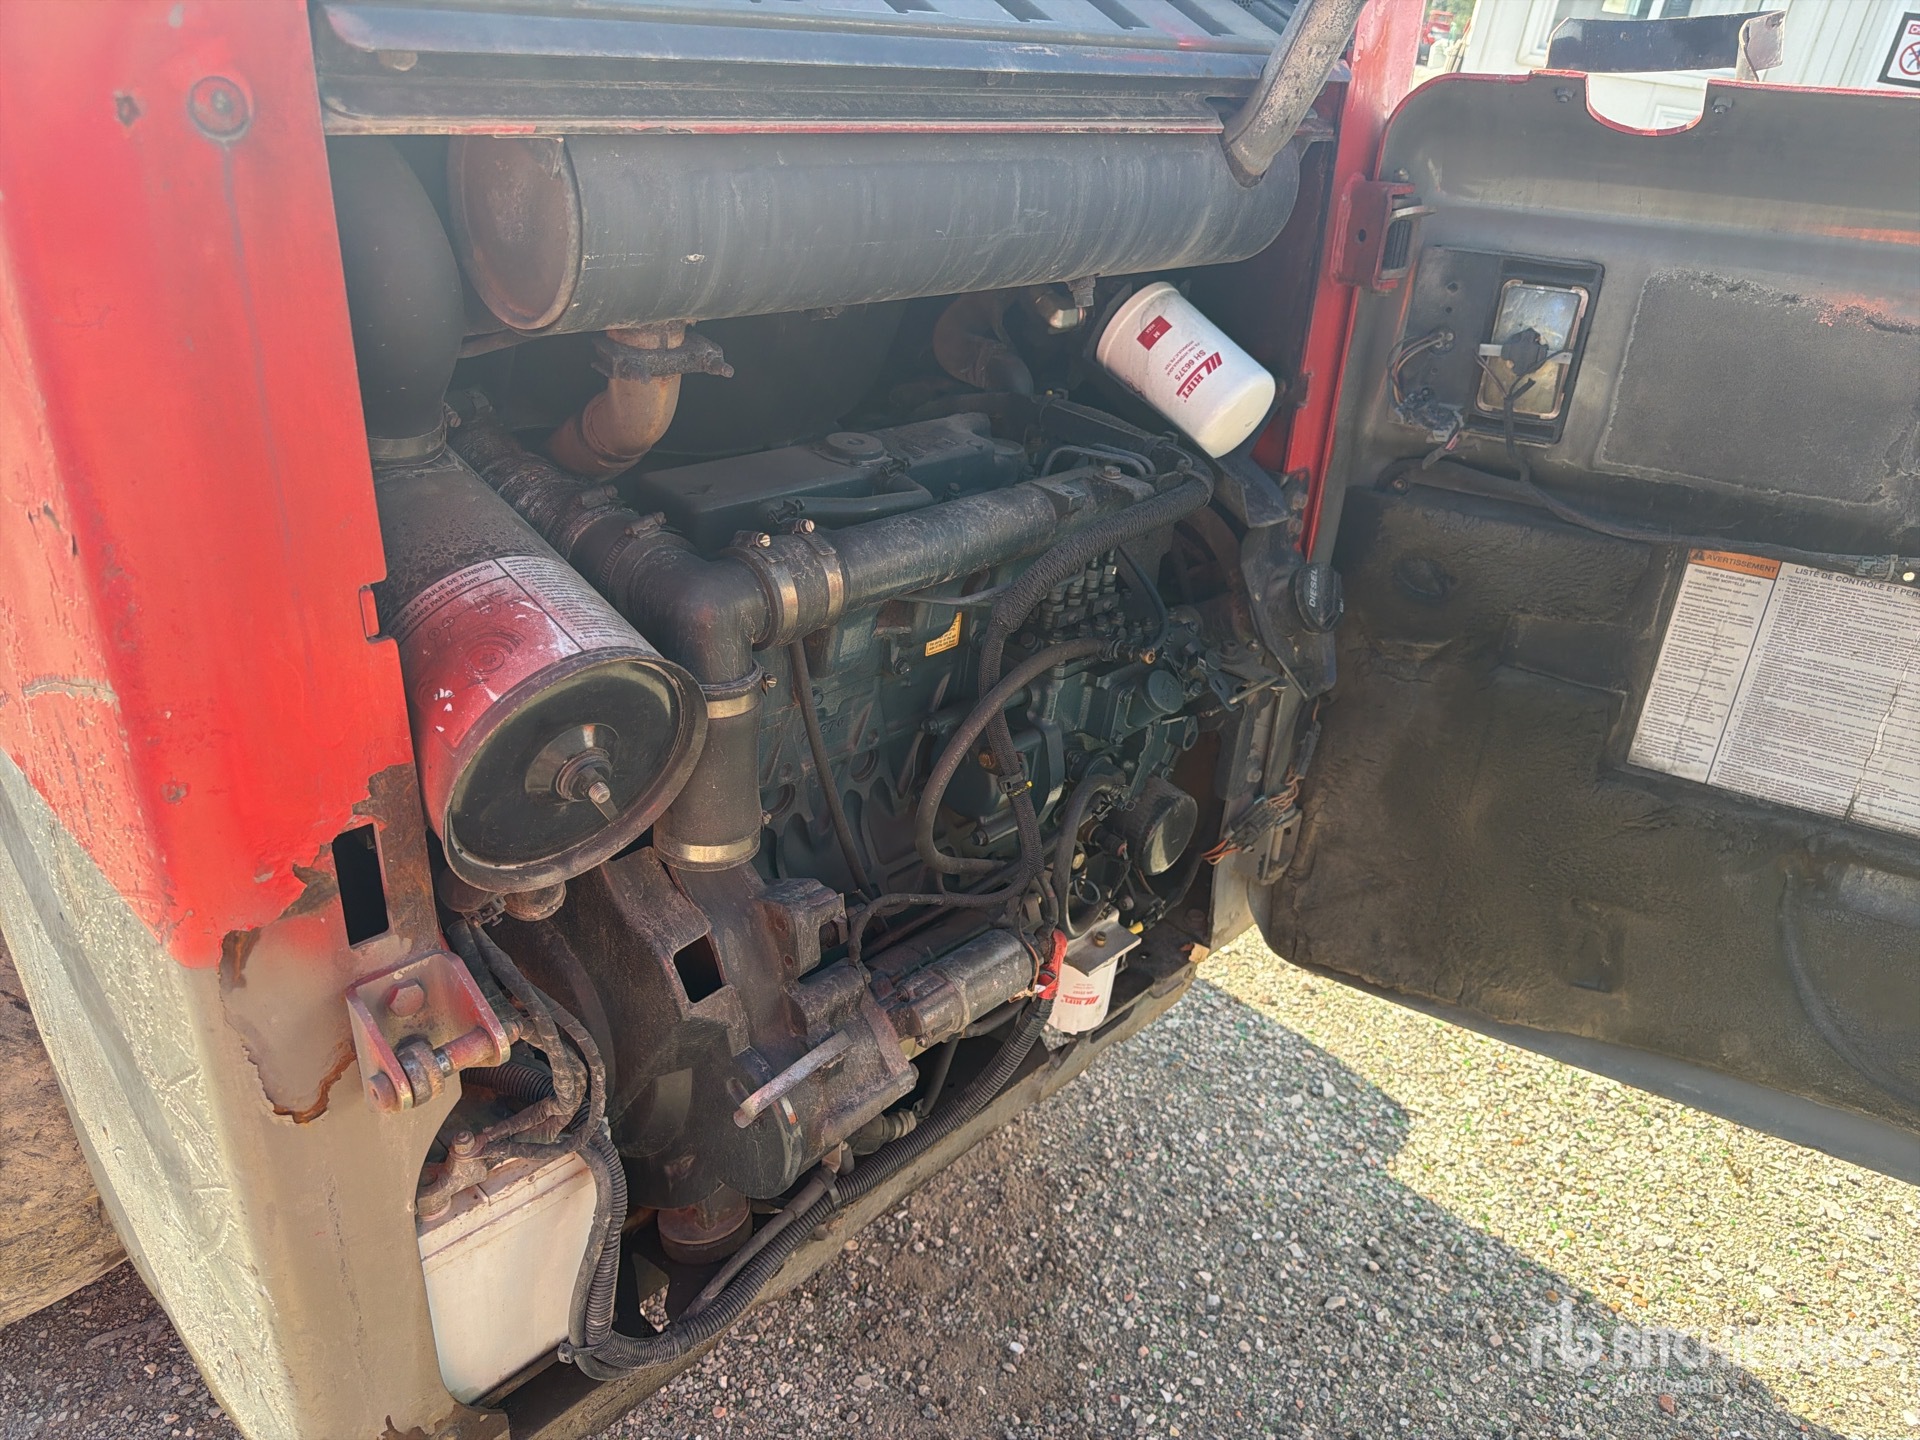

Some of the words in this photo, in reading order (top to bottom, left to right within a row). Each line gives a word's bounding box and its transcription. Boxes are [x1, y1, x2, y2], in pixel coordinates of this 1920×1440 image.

[1194, 350, 1206, 360] SH
[1174, 360, 1195, 381] 66375
[1182, 374, 1204, 399] HIFI
[1706, 553, 1777, 574] AVERTISSEMENT
[409, 603, 419, 613] LA
[420, 583, 447, 603] POULIE
[446, 577, 458, 585] DE
[459, 564, 493, 580] TENSION
[430, 595, 445, 607] PAR
[445, 576, 480, 597] RESSORT
[1309, 569, 1318, 608] DIESEL
[1795, 567, 1820, 578] LISTE
[1821, 572, 1834, 581] DE
[1835, 576, 1886, 591] CONTRÔLE
[1886, 586, 1900, 594] ET
